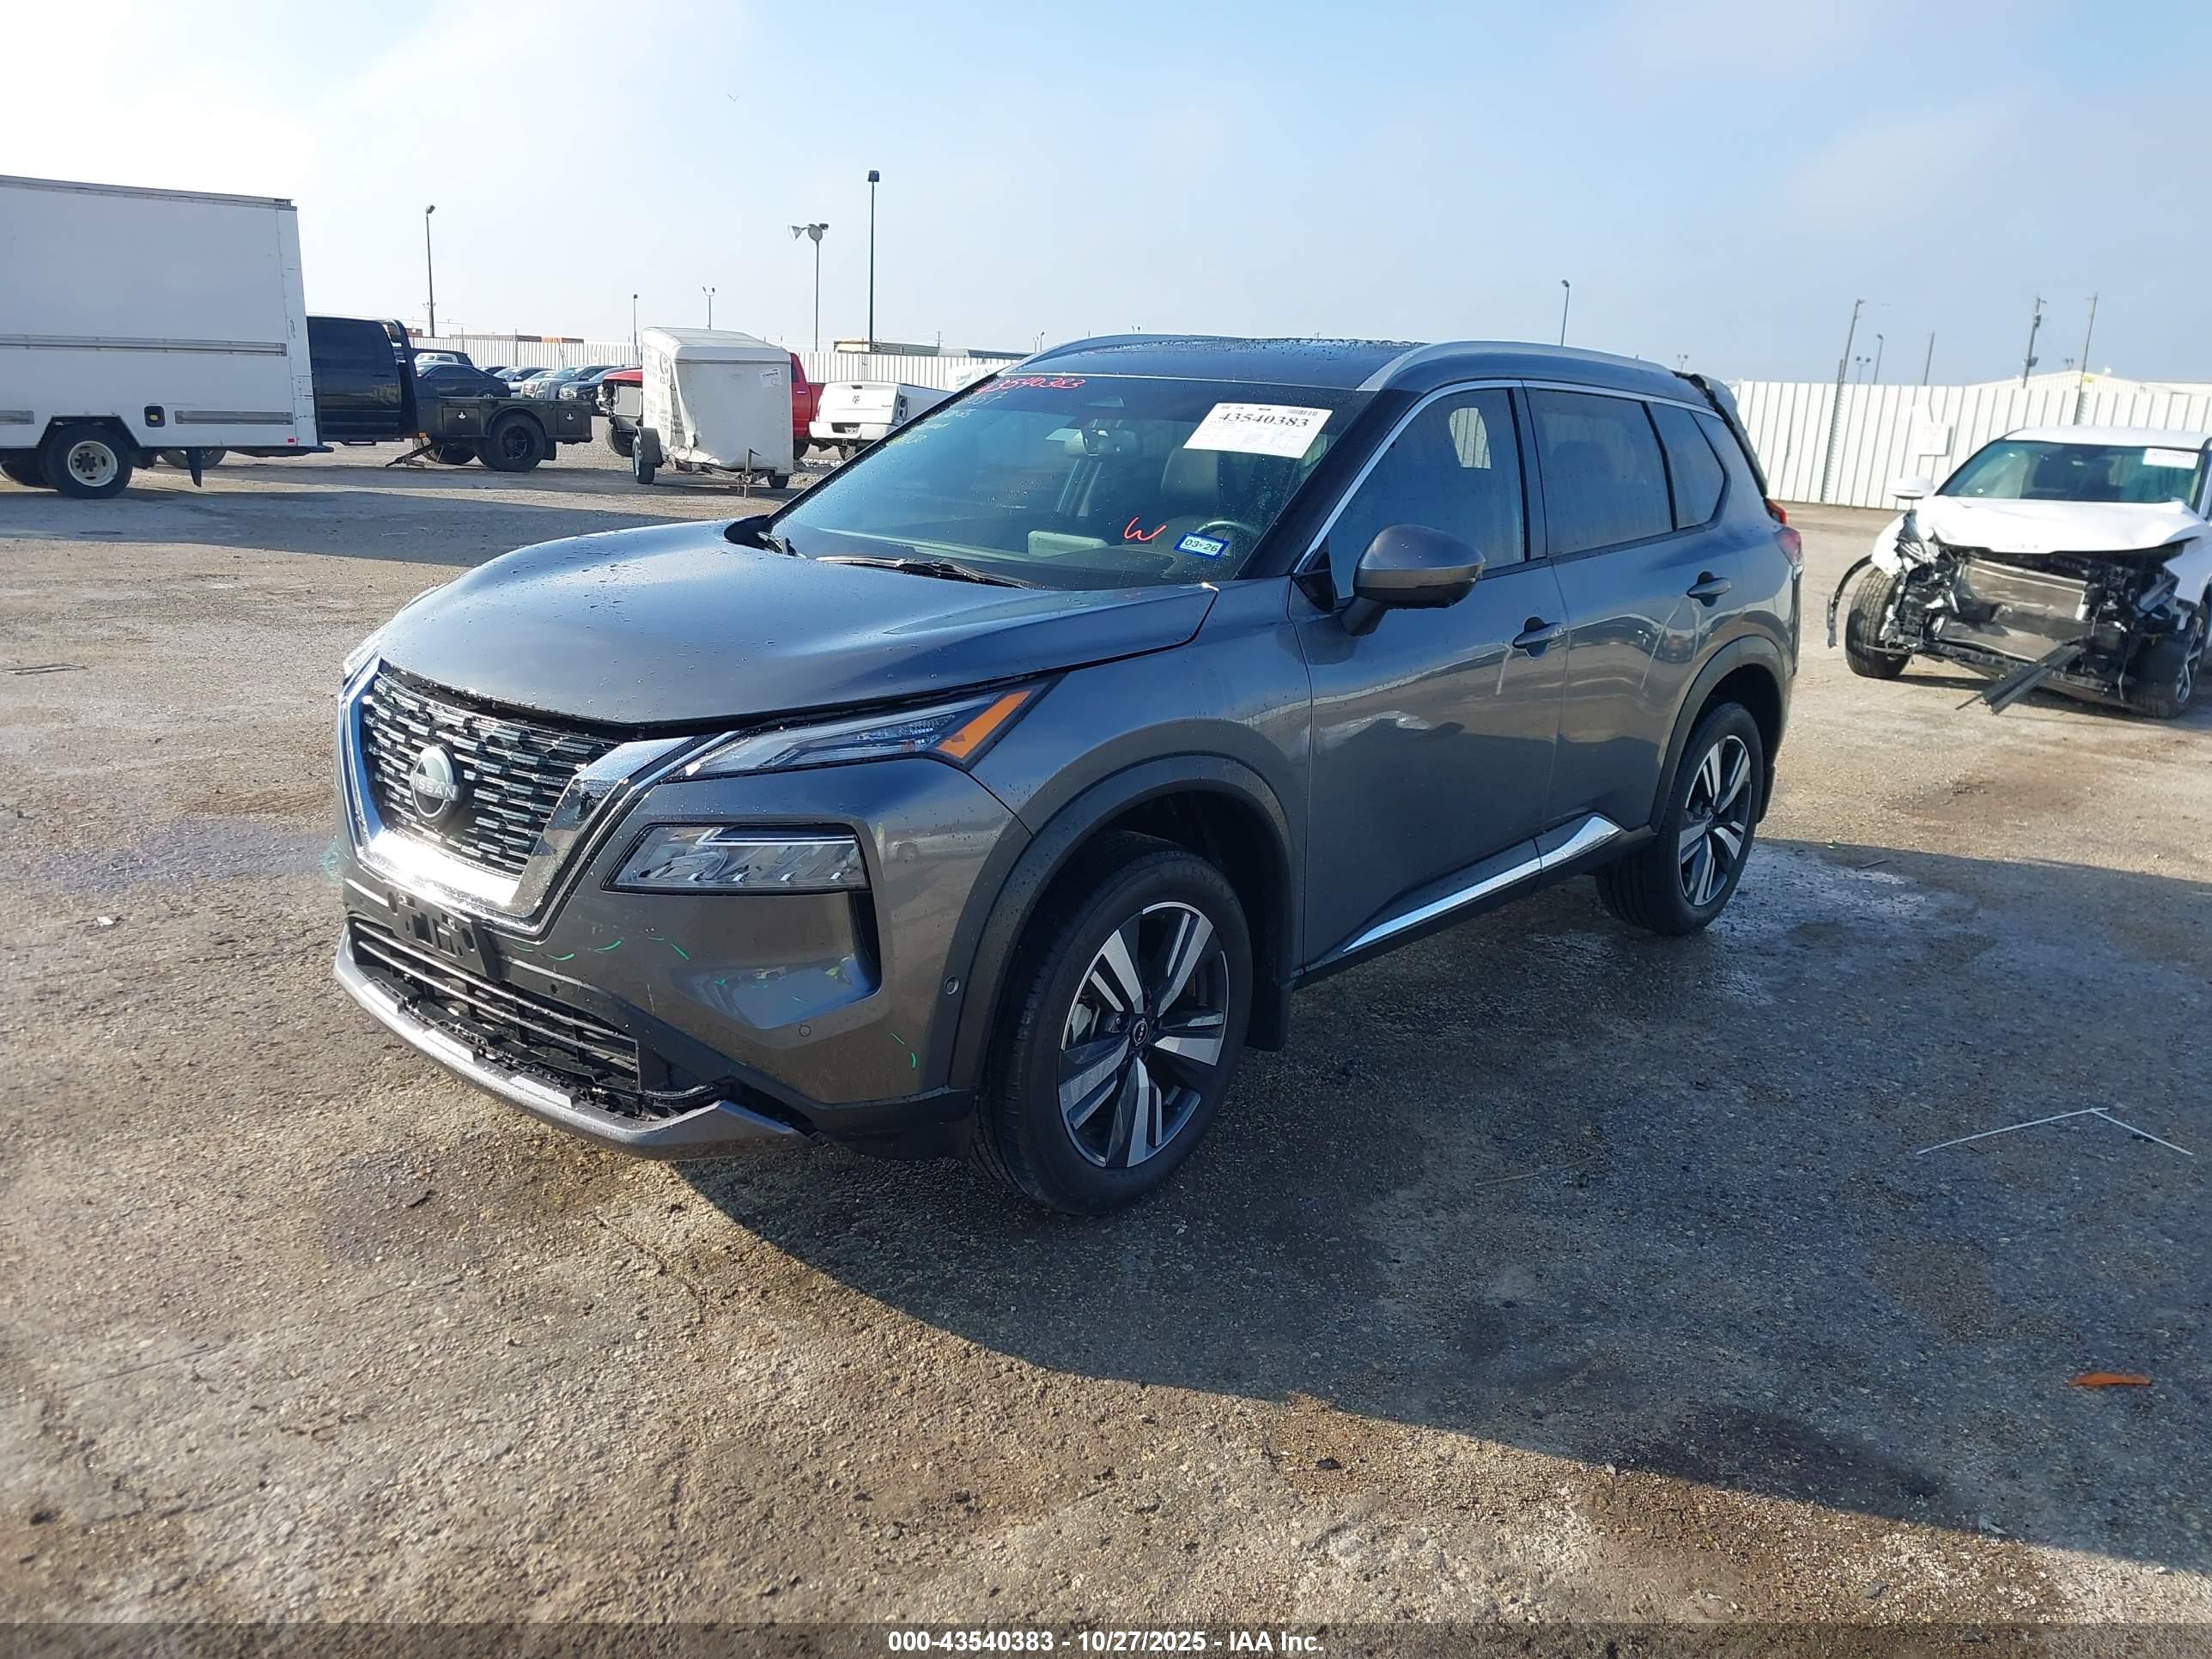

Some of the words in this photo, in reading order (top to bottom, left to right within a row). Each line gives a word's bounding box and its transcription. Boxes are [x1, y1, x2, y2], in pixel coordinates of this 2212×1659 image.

[1218, 412, 1310, 428] 43540383
[1184, 538, 1199, 548] 03
[1203, 543, 1219, 552] 26
[410, 772, 456, 799] NISSAN
